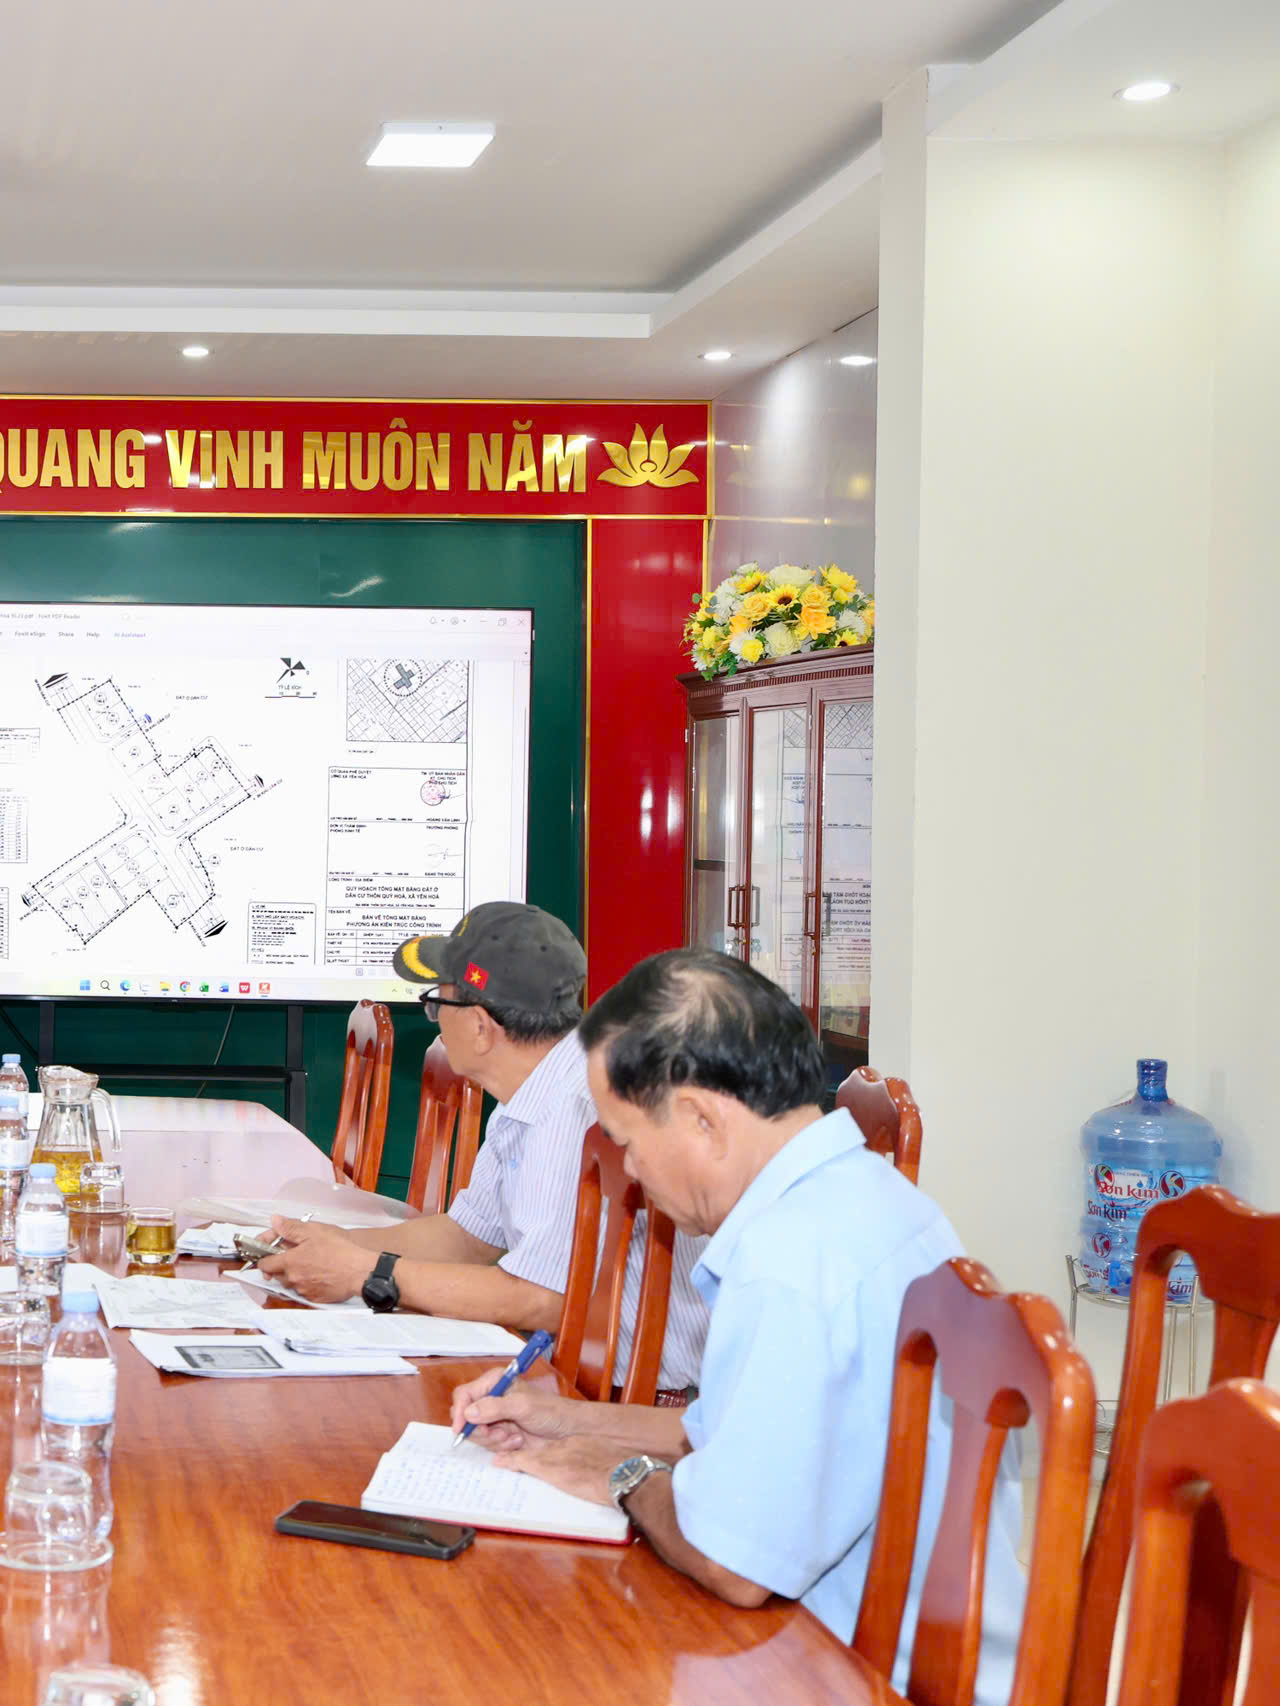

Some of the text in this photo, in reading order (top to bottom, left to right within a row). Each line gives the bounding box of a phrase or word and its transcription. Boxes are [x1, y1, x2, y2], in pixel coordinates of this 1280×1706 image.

[165, 429, 284, 489] VINH
[302, 417, 450, 491] MUÔN
[468, 419, 587, 493] NĂM
[1127, 1180, 1159, 1200] kim
[1104, 1202, 1127, 1223] kim
